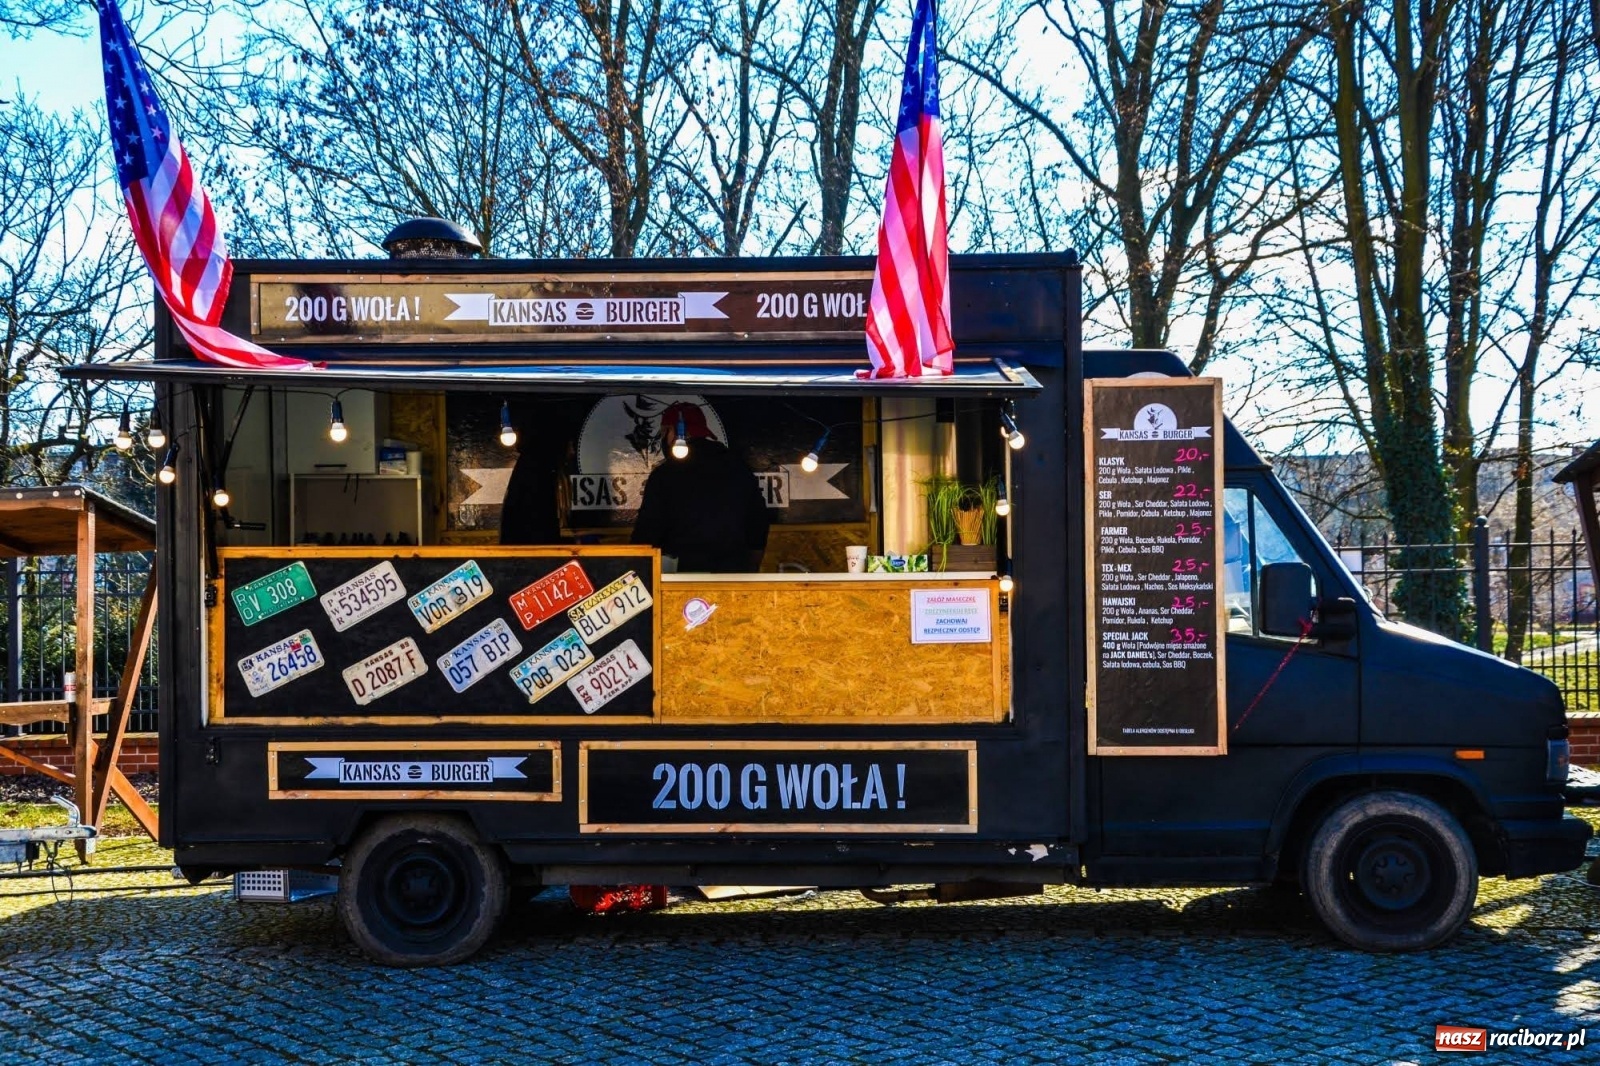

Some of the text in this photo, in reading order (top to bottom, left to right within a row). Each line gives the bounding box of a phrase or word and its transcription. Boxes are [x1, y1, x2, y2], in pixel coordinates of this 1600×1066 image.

[285, 296, 327, 321] 200
[332, 296, 347, 321] G
[493, 301, 680, 323] KANSAS BURGER
[756, 293, 798, 319] 200
[803, 293, 818, 319] G
[1119, 430, 1193, 440] KANSAS BURGER
[1098, 457, 1125, 466] KLASYK
[1098, 467, 1111, 475] 200
[1098, 491, 1112, 500] SER
[1135, 500, 1144, 508] Ser
[1101, 527, 1128, 535] FARMER
[1101, 536, 1113, 544] 200
[1141, 545, 1151, 553] Sos
[1152, 545, 1165, 554] BBQ
[338, 572, 377, 598] KANSAS
[427, 574, 459, 597] KANSAS
[1101, 573, 1114, 581] 200
[1137, 573, 1147, 581] Ser
[1168, 582, 1178, 590] Sos
[266, 578, 297, 604] 308
[338, 572, 398, 616] 534595
[418, 597, 452, 625] VOR
[454, 574, 484, 605] 819
[533, 579, 574, 612] 1142
[583, 580, 624, 611] KANSAS
[1102, 597, 1136, 606] HAWAJSKI
[578, 585, 646, 637] BLU 912
[1102, 607, 1115, 615] 200
[1160, 607, 1170, 615] Ser
[1151, 616, 1173, 625] Ketchup
[453, 629, 491, 659] KANSAS
[1102, 631, 1149, 641] SPECIAL JACK
[1102, 642, 1116, 650] 400
[267, 645, 317, 682] 26458
[364, 649, 394, 669] KANSAS
[448, 632, 510, 685] 057 BIP
[528, 641, 560, 667] KANSAS
[1110, 651, 1126, 659] JACK
[1157, 651, 1167, 659] Ser
[1162, 660, 1172, 668] Sos
[1173, 660, 1186, 669] BBQ
[351, 649, 416, 697] D 2087 F
[521, 643, 586, 696] PQB 023
[587, 654, 617, 677] KANSAS
[590, 654, 638, 696] 90214
[343, 763, 490, 781] KANSAS BURGER
[652, 763, 731, 810] 200
[740, 763, 767, 810] G
